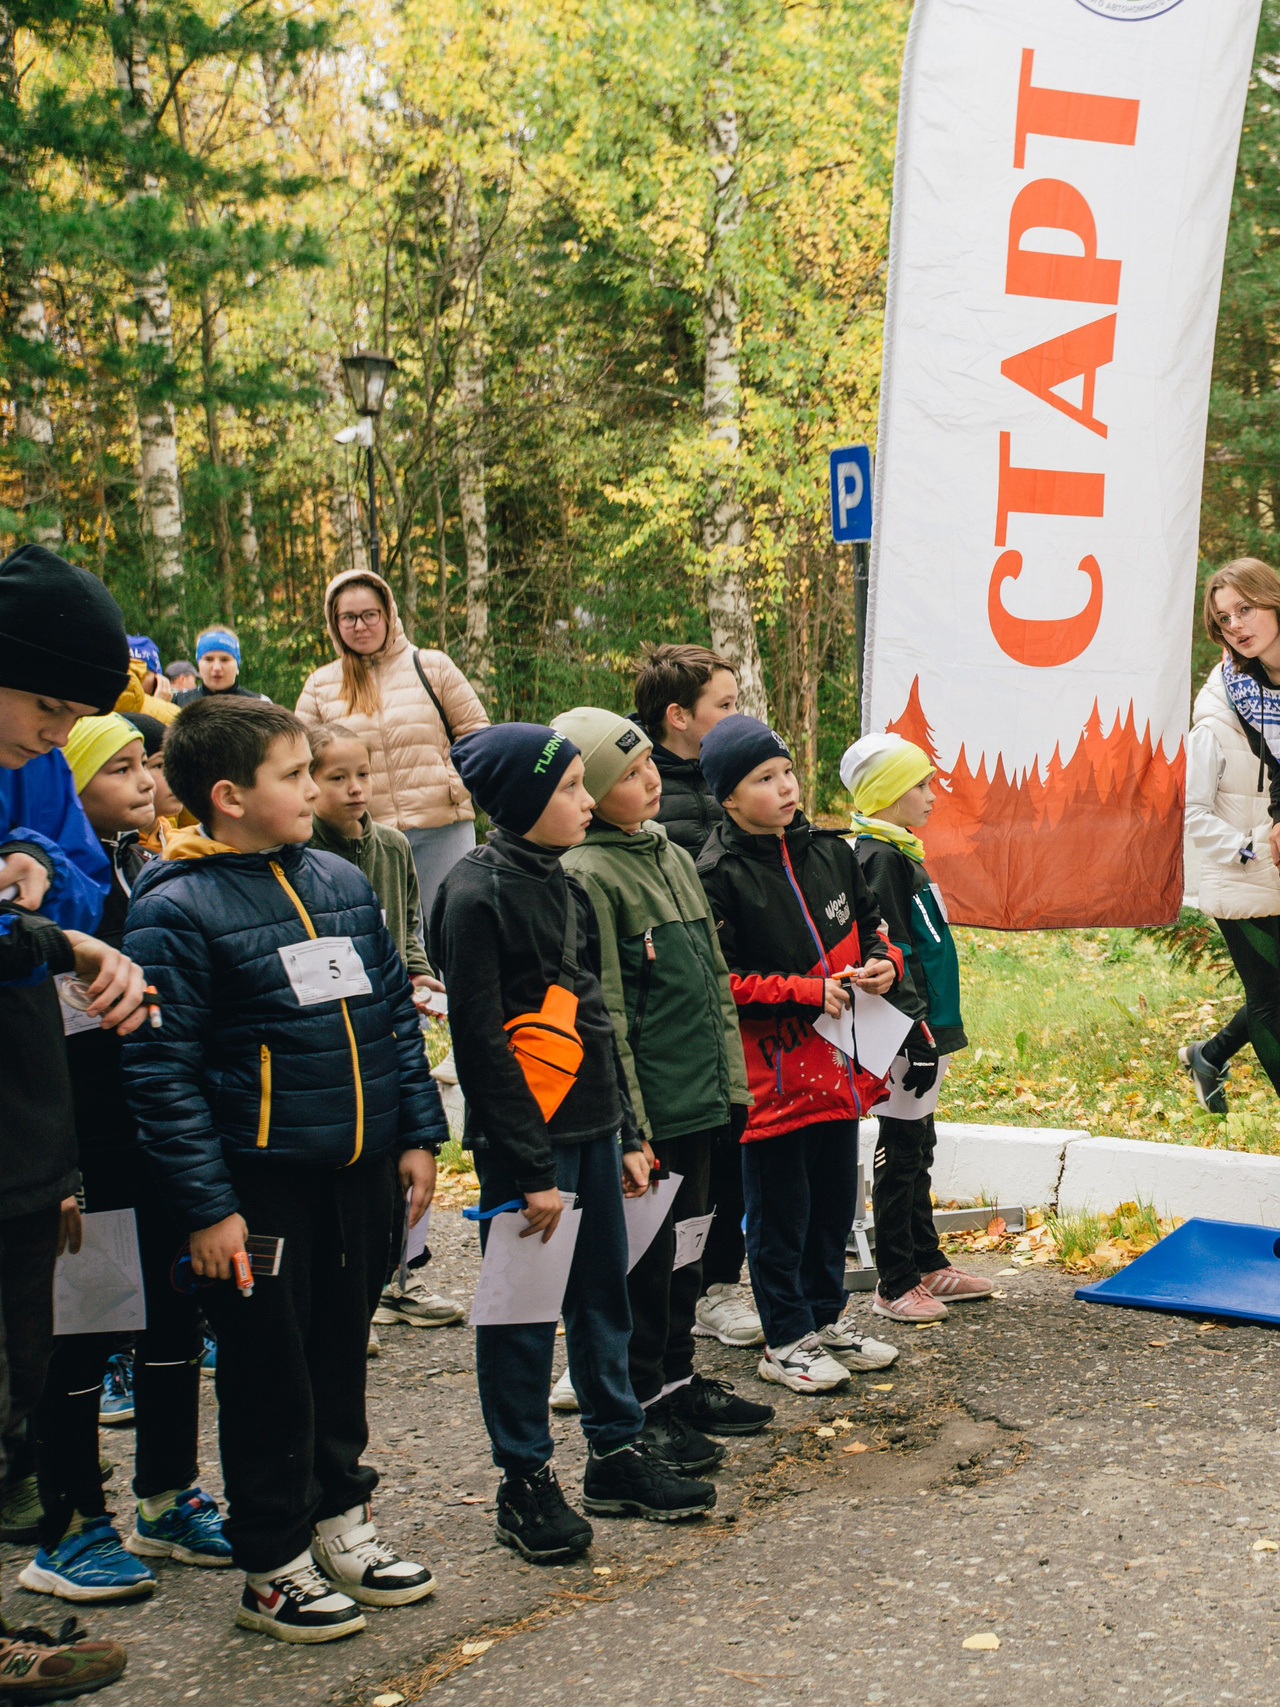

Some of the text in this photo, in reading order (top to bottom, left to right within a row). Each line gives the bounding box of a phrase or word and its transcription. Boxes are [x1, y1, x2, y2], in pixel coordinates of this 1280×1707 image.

[988, 48, 1140, 668] СТАРТ
[837, 461, 864, 529] P
[329, 959, 342, 980] 5
[695, 1232, 704, 1249] 7
